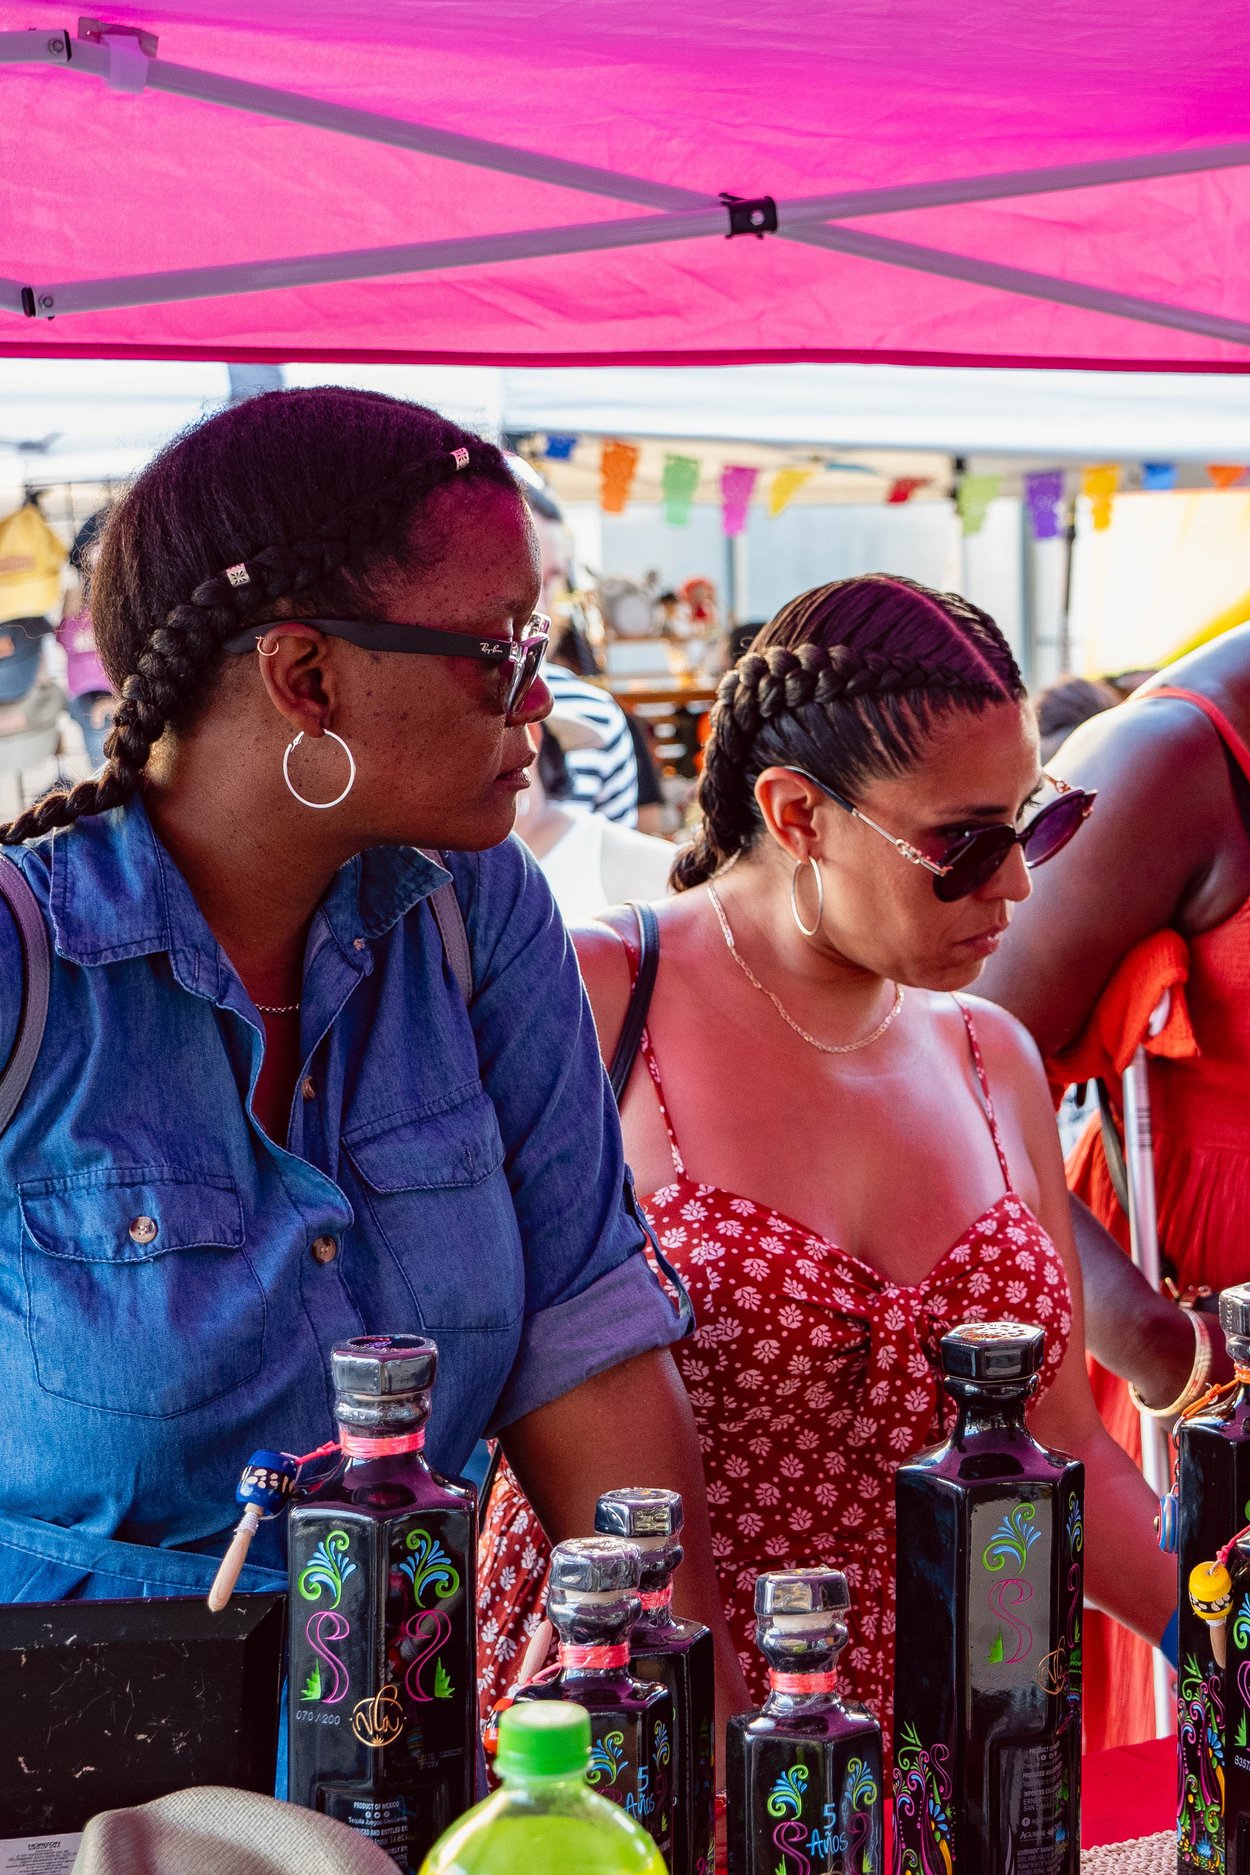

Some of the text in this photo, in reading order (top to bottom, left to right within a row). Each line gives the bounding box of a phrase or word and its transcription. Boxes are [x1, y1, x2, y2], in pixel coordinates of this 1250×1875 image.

[637, 1765, 649, 1792] 5
[823, 1803, 837, 1829] 5
[806, 1828, 849, 1858] Años
